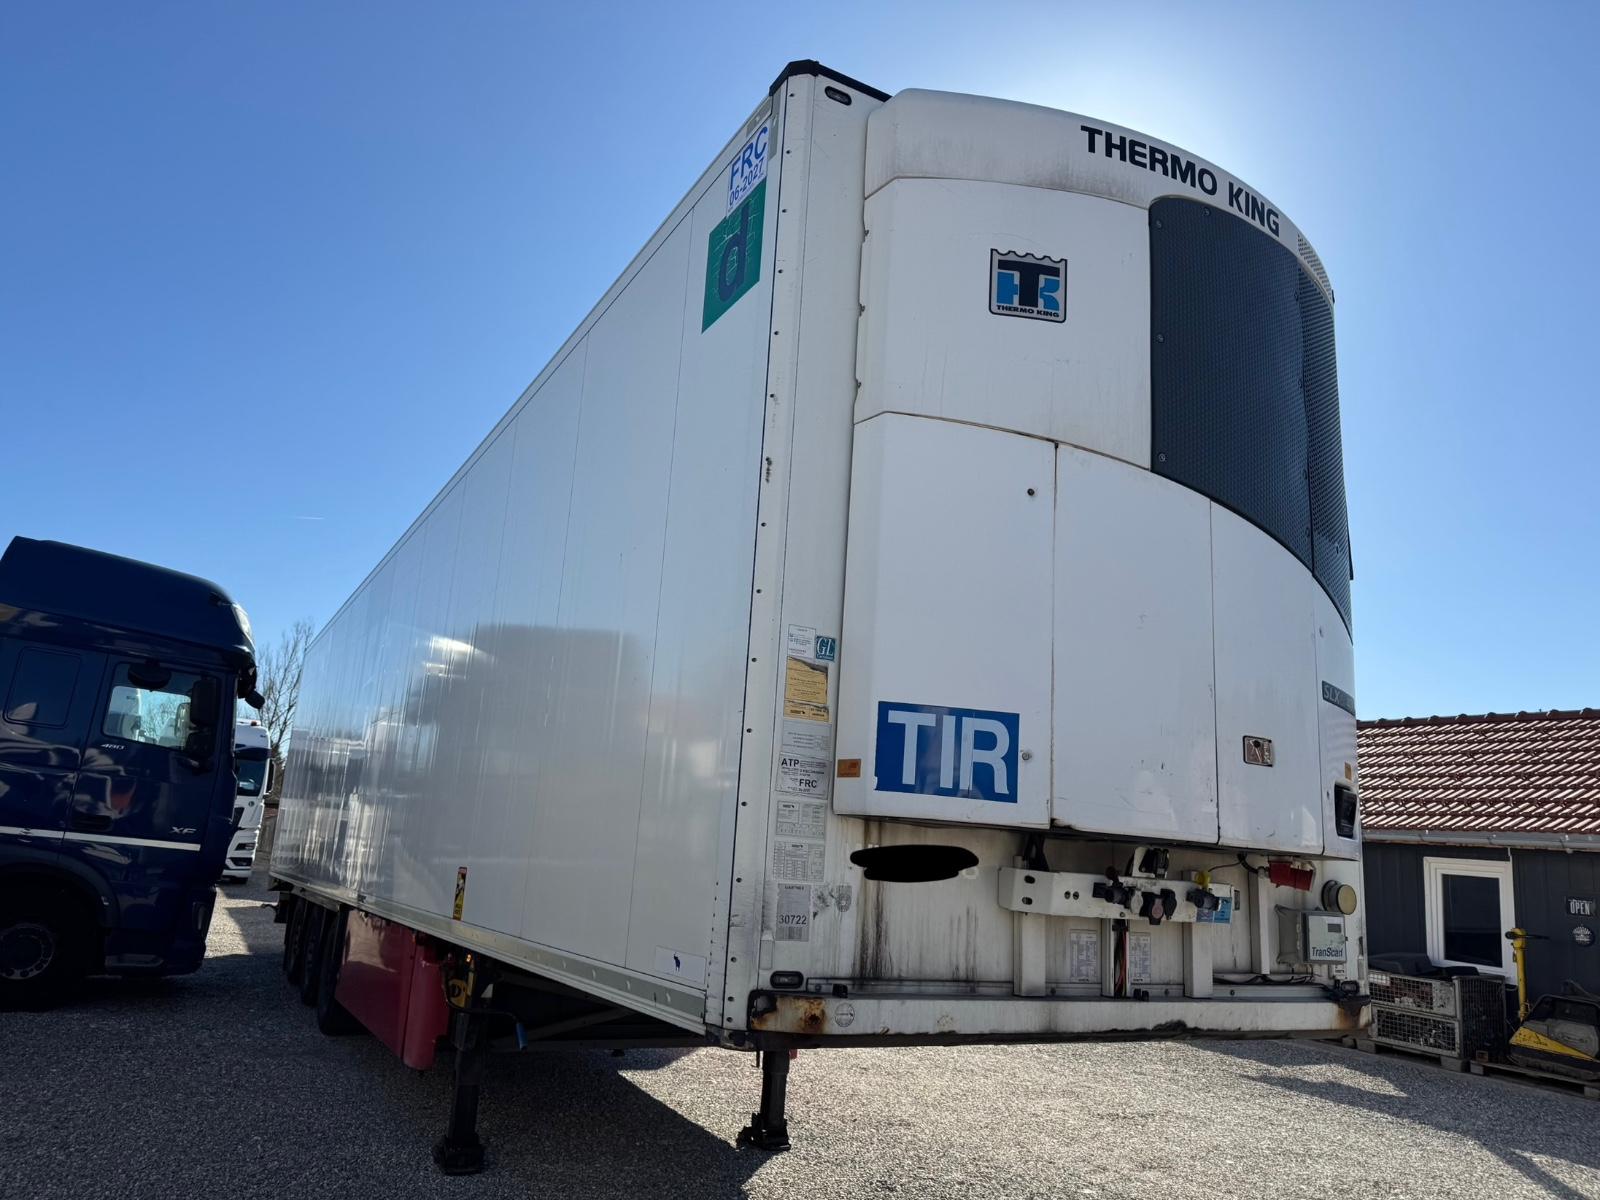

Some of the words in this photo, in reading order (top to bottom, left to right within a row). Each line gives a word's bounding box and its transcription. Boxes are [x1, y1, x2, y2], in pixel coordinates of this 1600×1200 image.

[729, 126, 768, 191] FRC
[729, 156, 765, 207] 06-2027
[1081, 125, 1218, 196] THERMO
[1228, 181, 1280, 238] KING
[996, 304, 1035, 314] THERMO
[1036, 309, 1060, 318] KING
[816, 636, 835, 657] GL
[1323, 684, 1341, 705] SLX
[887, 709, 1010, 795] TIR
[781, 757, 800, 767] ATP
[799, 778, 817, 789] FRC
[170, 826, 197, 835] XF
[1570, 900, 1591, 915] OPEN
[778, 914, 807, 925] 30722
[1311, 946, 1344, 958] TranScan
